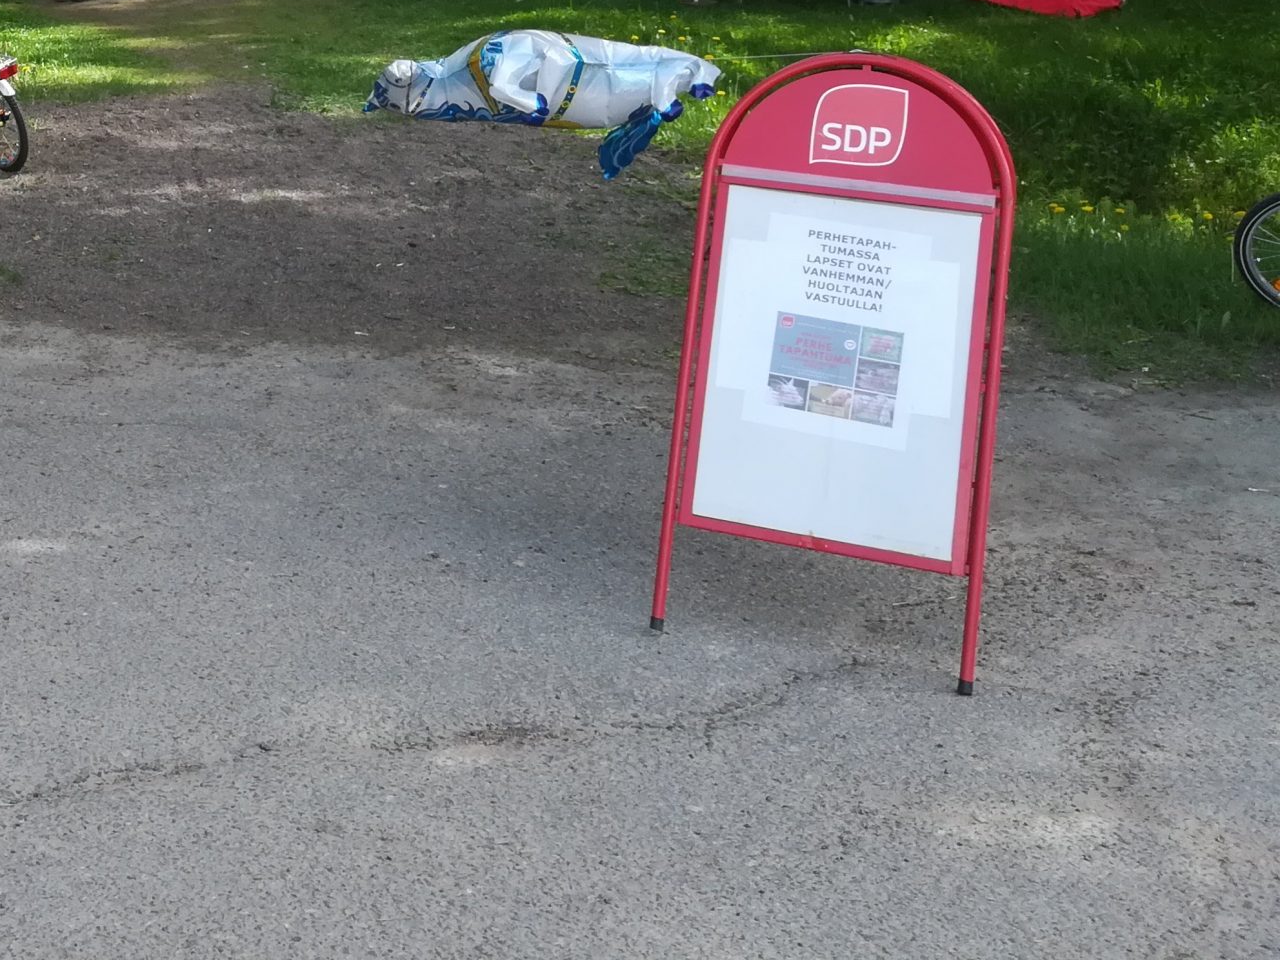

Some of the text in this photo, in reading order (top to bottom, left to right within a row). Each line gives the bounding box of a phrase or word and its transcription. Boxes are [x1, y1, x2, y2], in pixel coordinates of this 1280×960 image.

[821, 122, 892, 154] SDP
[807, 229, 897, 251] PERHETAPAH-
[820, 244, 881, 261] TUMASSA
[806, 254, 892, 276] LAPSET OVAT
[802, 265, 893, 290] VANHEMMAN/
[807, 279, 883, 300] HUOLTAJAN
[804, 291, 883, 313] VASTUULLA!
